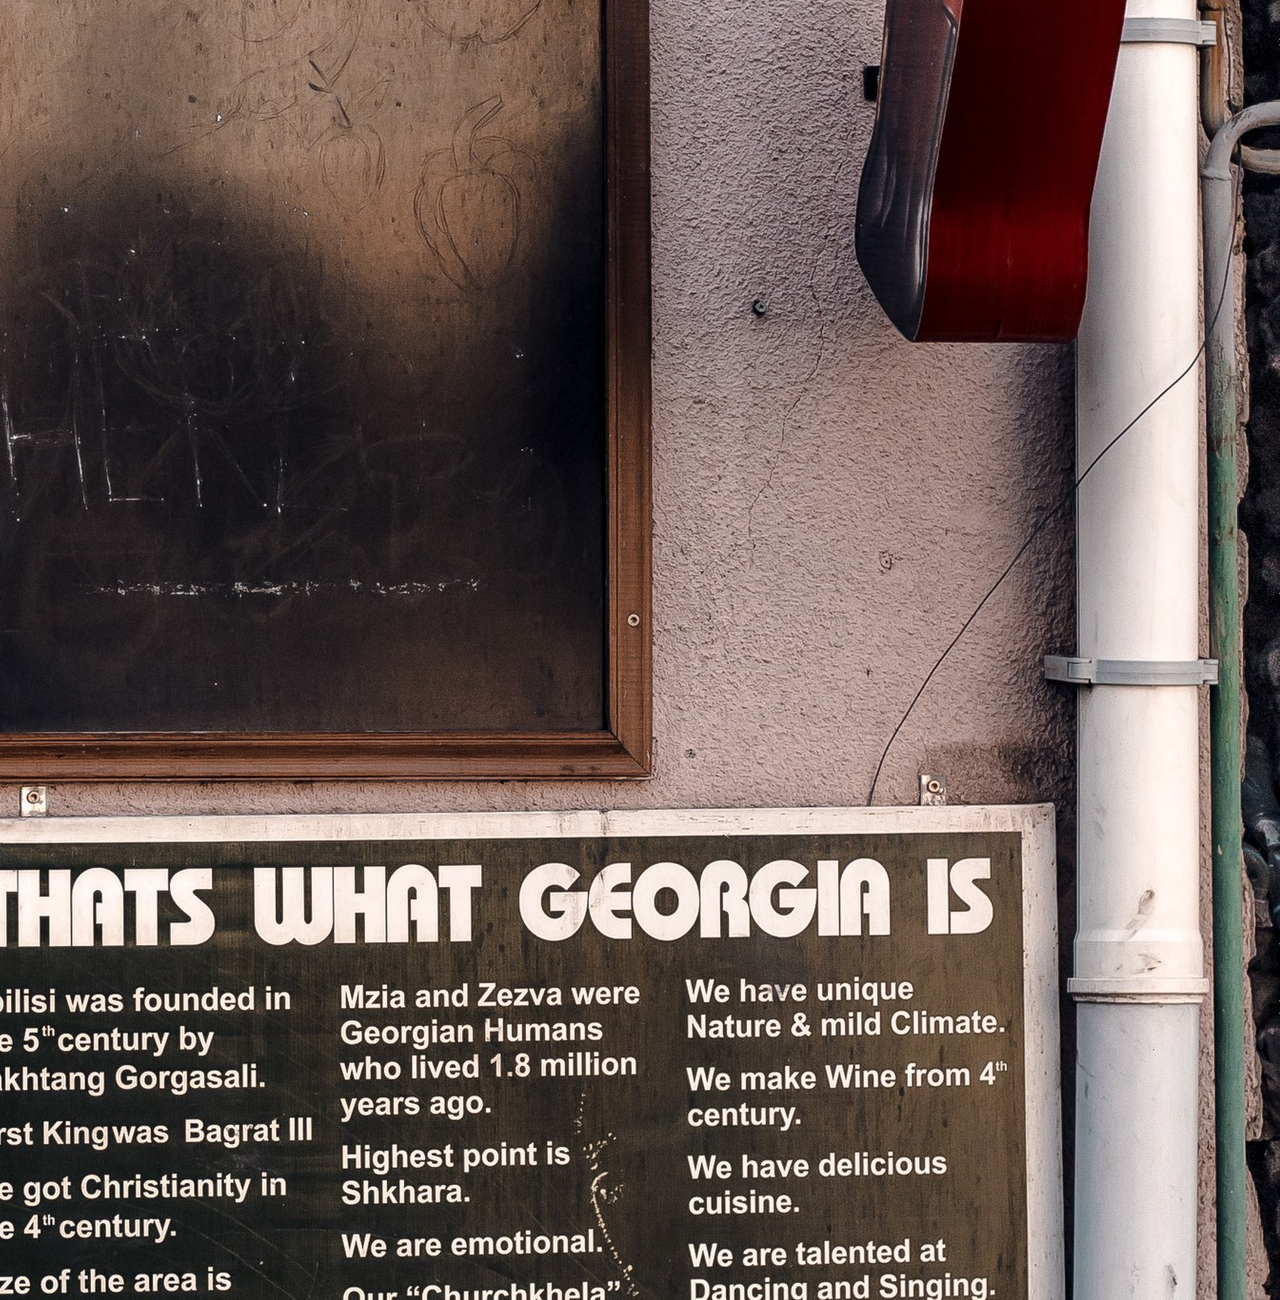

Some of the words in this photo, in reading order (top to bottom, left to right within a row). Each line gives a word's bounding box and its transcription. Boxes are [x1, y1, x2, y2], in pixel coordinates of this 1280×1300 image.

[253, 863, 483, 946] WHAT
[518, 857, 891, 942] GEORGIA
[926, 857, 994, 935] IS
[65, 993, 124, 1013] was
[132, 985, 255, 1012] founded
[265, 985, 291, 1011] in
[340, 984, 406, 1009] Mzia
[415, 982, 469, 1008] and
[477, 982, 563, 1007] Zezva
[570, 985, 641, 1005] were
[685, 978, 731, 1003] We
[740, 978, 808, 1003] have
[817, 976, 914, 1007] unique
[340, 1018, 474, 1051] Georgian
[484, 1017, 604, 1042] Humans
[687, 1013, 782, 1039] Nature
[790, 1012, 812, 1037] &
[821, 1011, 881, 1037] mild
[890, 1009, 1005, 1036] Climate.
[57, 1027, 170, 1057] century
[179, 1025, 215, 1057] by
[115, 1063, 266, 1096] Gorgasali.
[339, 1055, 402, 1081] who
[411, 1053, 480, 1079] lived
[490, 1052, 531, 1078] 1.8
[540, 1051, 637, 1077] million
[685, 1066, 731, 1092] We
[740, 1065, 817, 1091] make
[824, 1063, 897, 1089] Wine
[904, 1062, 971, 1087] from
[339, 1096, 420, 1123] years
[429, 1095, 492, 1121] ago.
[687, 1102, 802, 1132] century.
[43, 1120, 109, 1151] King
[111, 1125, 169, 1144] was
[185, 1118, 280, 1149] Bagrat
[289, 1116, 313, 1141] III
[342, 1143, 455, 1175] Highest
[463, 1141, 538, 1173] point
[546, 1140, 571, 1166] is
[687, 1154, 733, 1180] We
[741, 1154, 810, 1179] have
[818, 1150, 948, 1177] delicious
[23, 1175, 72, 1207] got
[80, 1172, 252, 1203] Christianity
[261, 1171, 287, 1197] in
[341, 1179, 470, 1206] Shkhara.
[688, 1189, 800, 1215] cuisine.
[59, 1213, 177, 1244] century.
[341, 1233, 387, 1258] We
[396, 1237, 442, 1257] are
[450, 1228, 603, 1256] emotional.
[688, 1242, 734, 1268] We
[742, 1247, 788, 1267] are
[795, 1238, 911, 1266] talented
[919, 1238, 947, 1263] at
[40, 1268, 71, 1294] of
[77, 1268, 125, 1294] the
[134, 1272, 197, 1293] area
[207, 1266, 232, 1291] is
[817, 1274, 870, 1300] and
